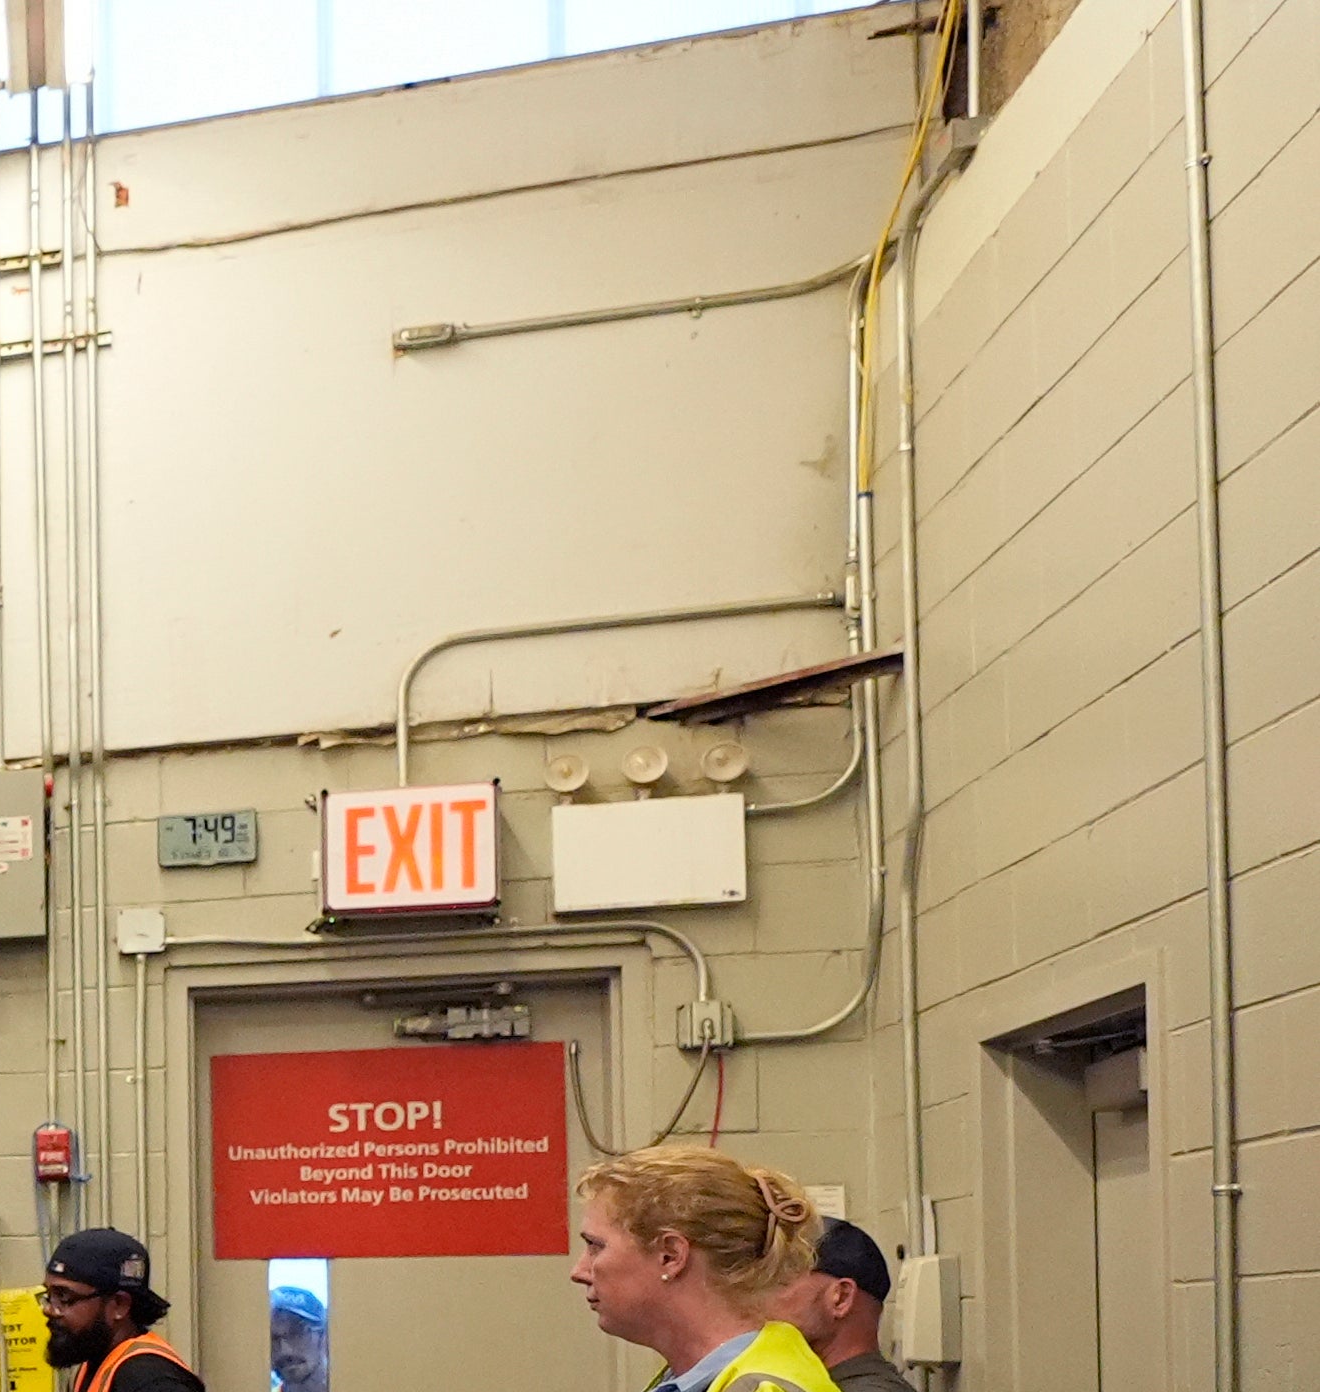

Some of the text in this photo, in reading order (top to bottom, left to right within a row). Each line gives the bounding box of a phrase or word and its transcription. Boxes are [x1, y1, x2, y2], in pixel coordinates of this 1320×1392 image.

[345, 799, 487, 895] EXIT
[328, 1100, 443, 1133] STOP!
[228, 1136, 549, 1161] Unauthorized Persons Prohibited
[300, 1162, 473, 1185] Beyond This Door
[250, 1182, 529, 1207] Violators May Be Prosecuted
